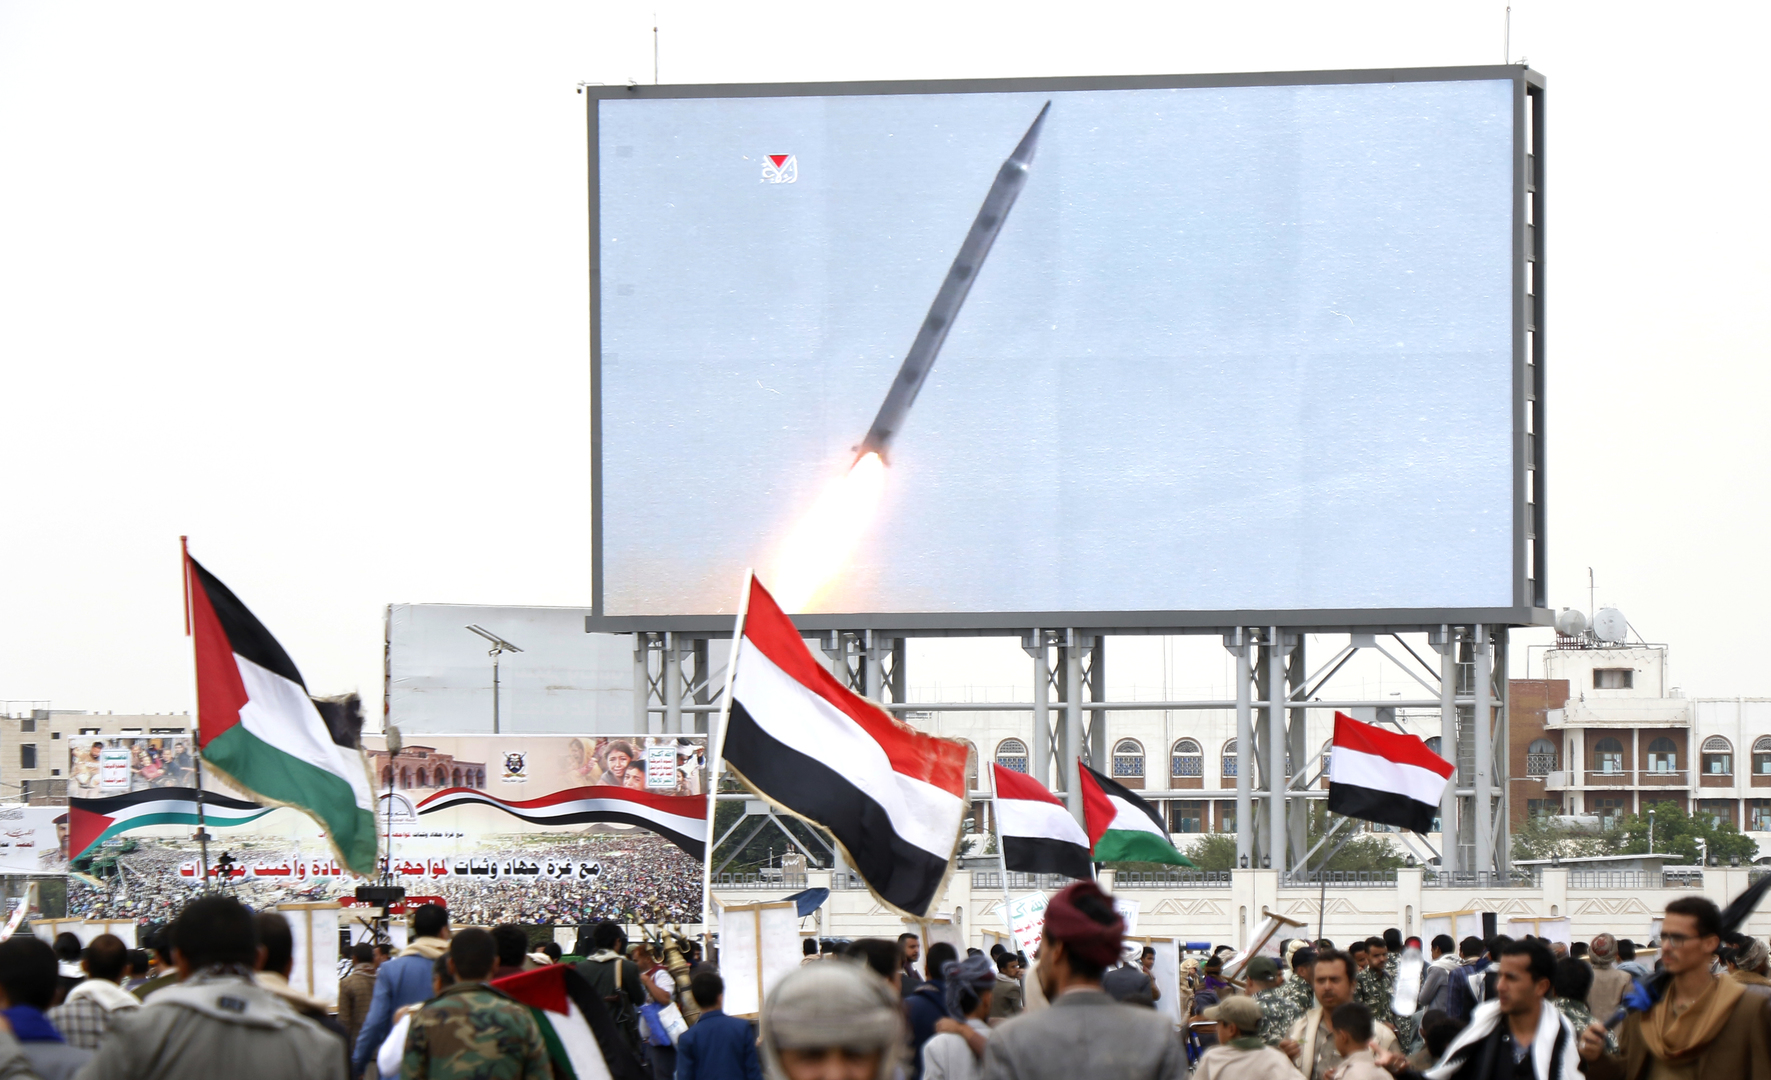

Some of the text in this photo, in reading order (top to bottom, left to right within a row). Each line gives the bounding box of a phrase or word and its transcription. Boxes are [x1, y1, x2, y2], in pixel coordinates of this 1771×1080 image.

[253, 854, 306, 880] وأخبث
[393, 858, 449, 879] لمواجهة
[454, 857, 498, 879] وثبات
[503, 858, 540, 879] جهاد
[546, 858, 573, 879] غزة
[578, 862, 600, 879] مع
